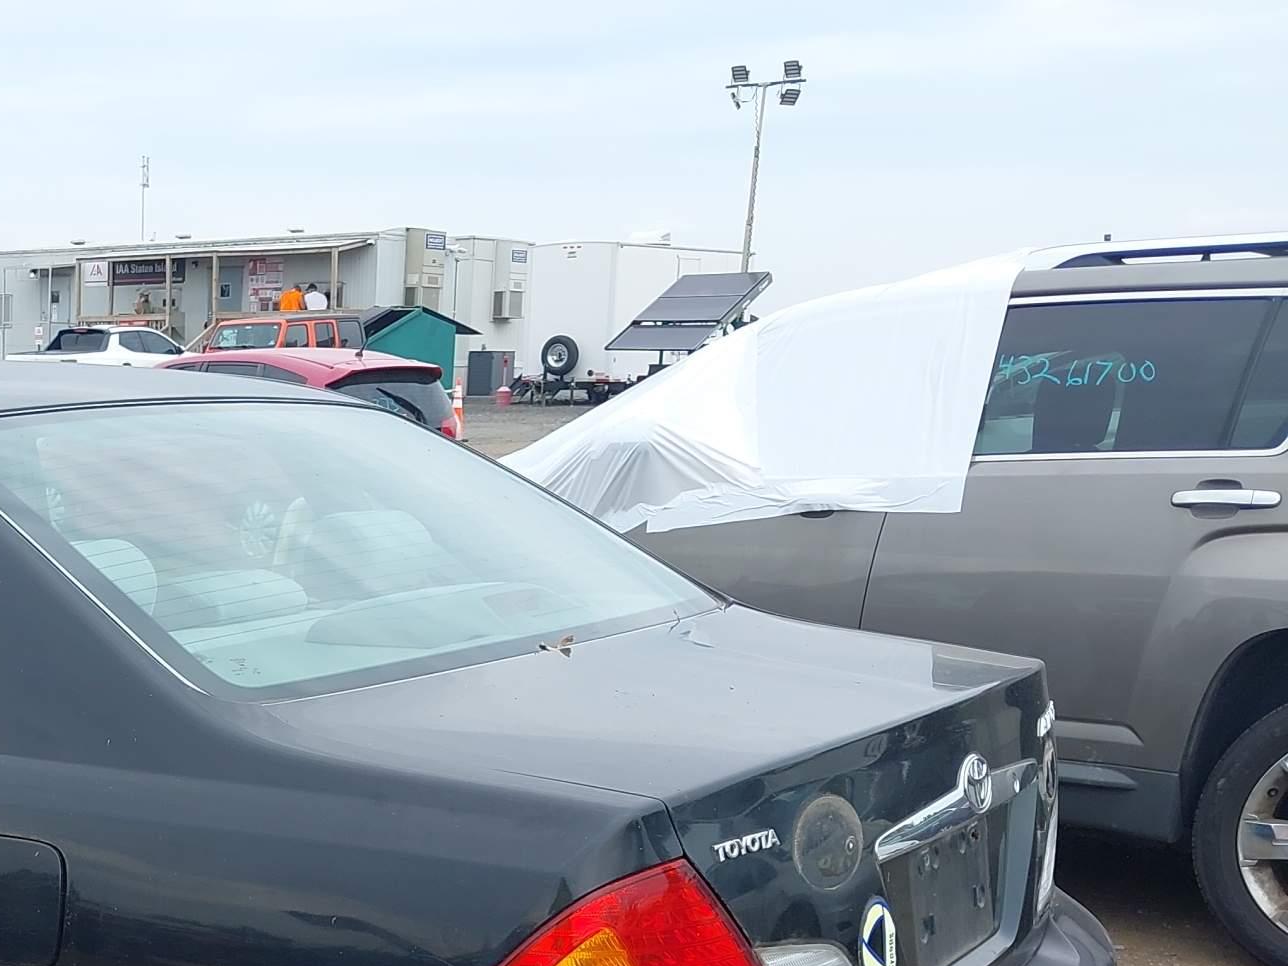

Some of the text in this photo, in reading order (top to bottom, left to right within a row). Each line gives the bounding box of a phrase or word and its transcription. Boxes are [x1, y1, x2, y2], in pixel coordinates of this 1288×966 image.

[116, 264, 129, 274] IAA
[130, 262, 154, 273] Staten
[712, 828, 781, 862] TOYOTA
